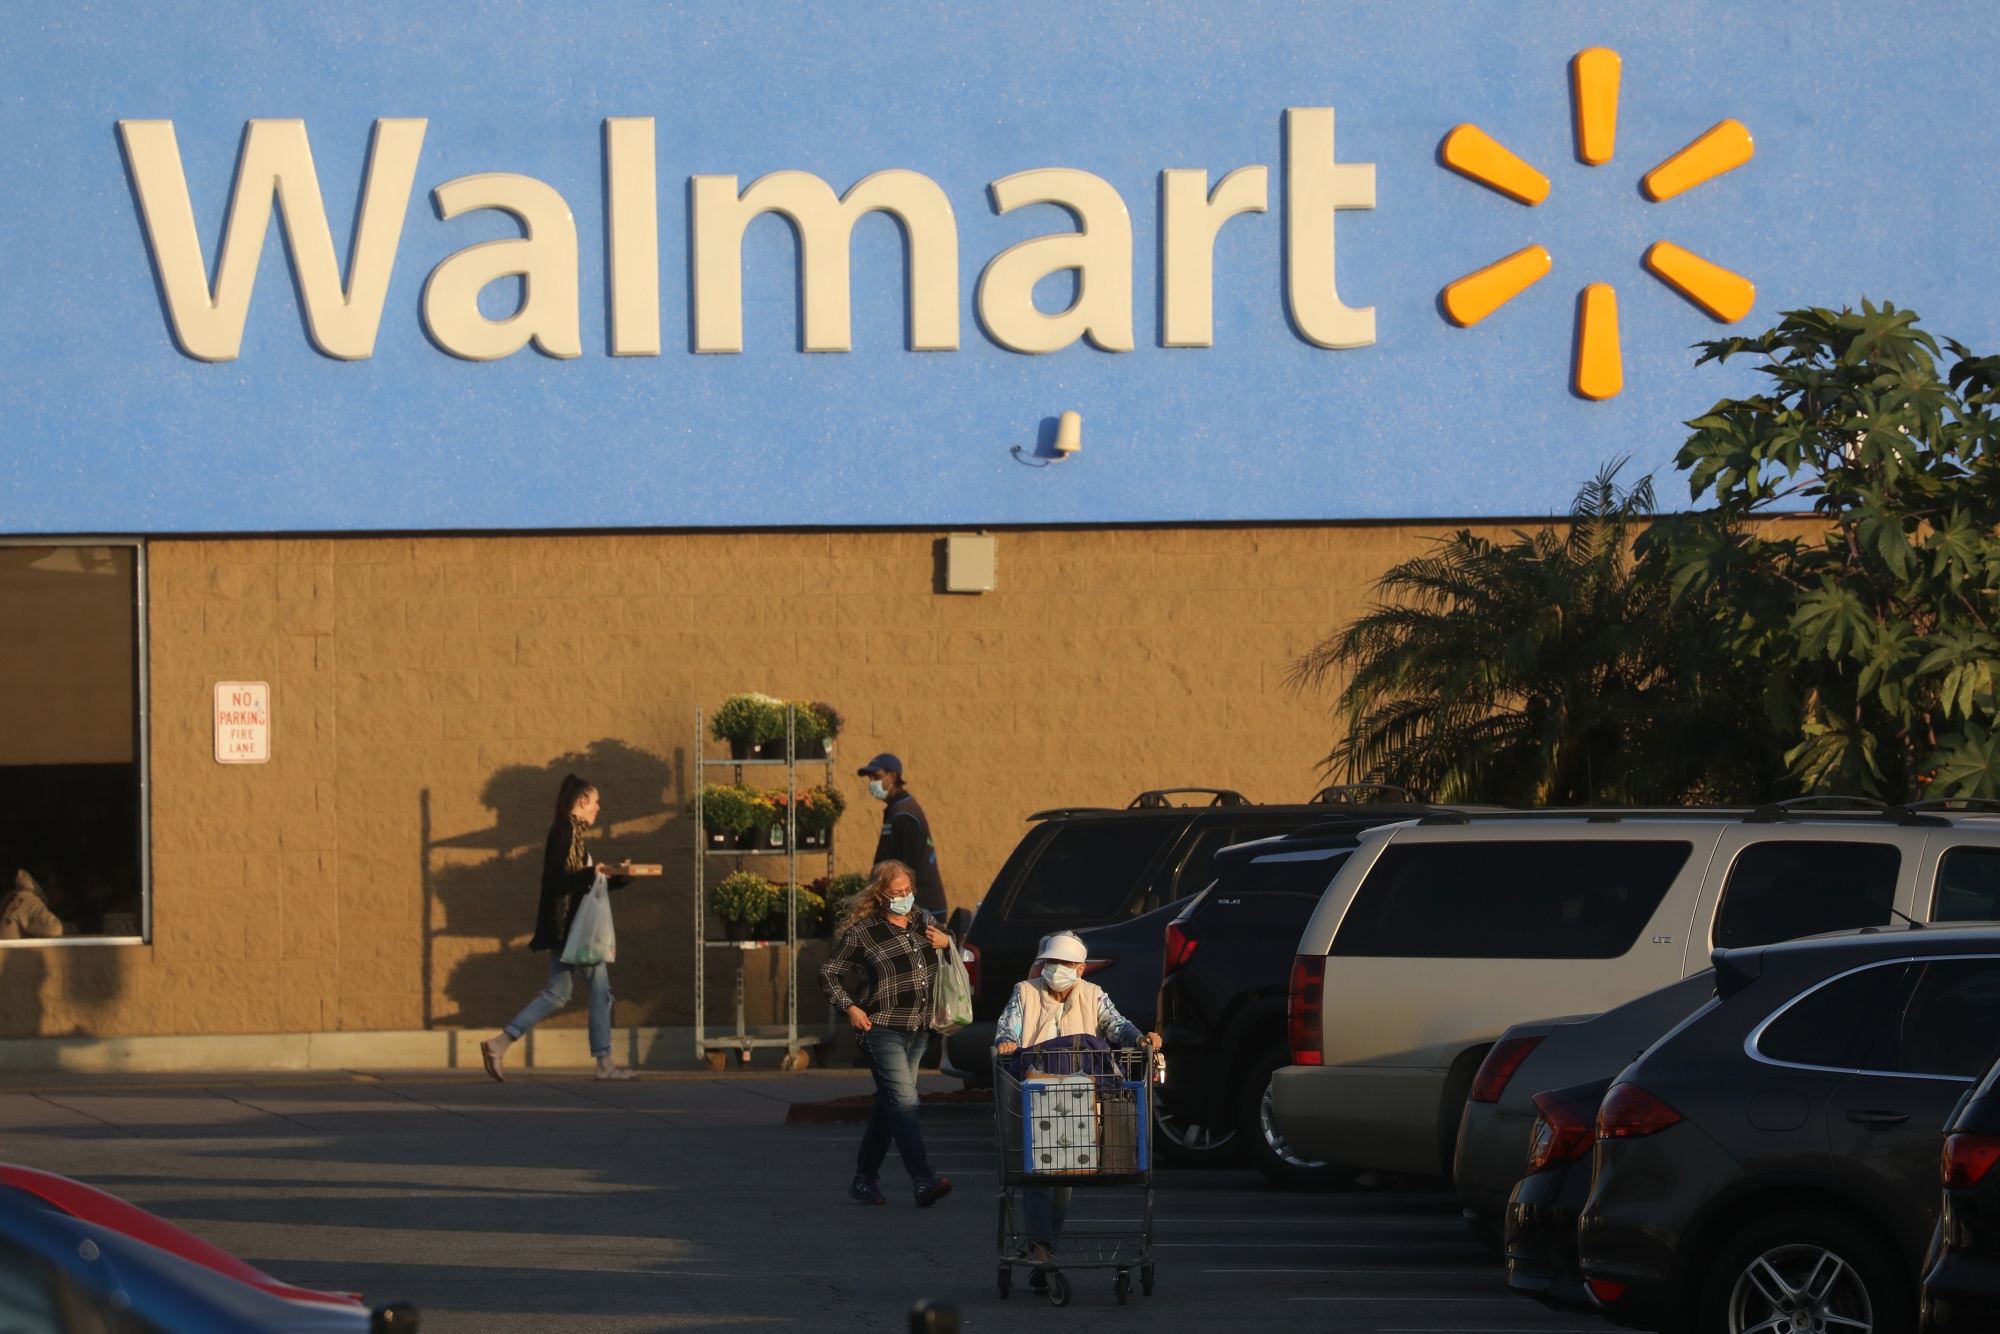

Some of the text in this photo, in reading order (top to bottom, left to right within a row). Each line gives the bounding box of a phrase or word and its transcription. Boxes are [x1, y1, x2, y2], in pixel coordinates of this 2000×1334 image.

[118, 107, 1376, 361] Walmart
[232, 692, 252, 707] NO
[231, 729, 254, 739] FIRE
[230, 743, 255, 753] LANE
[1652, 936, 1671, 944] LTZ
